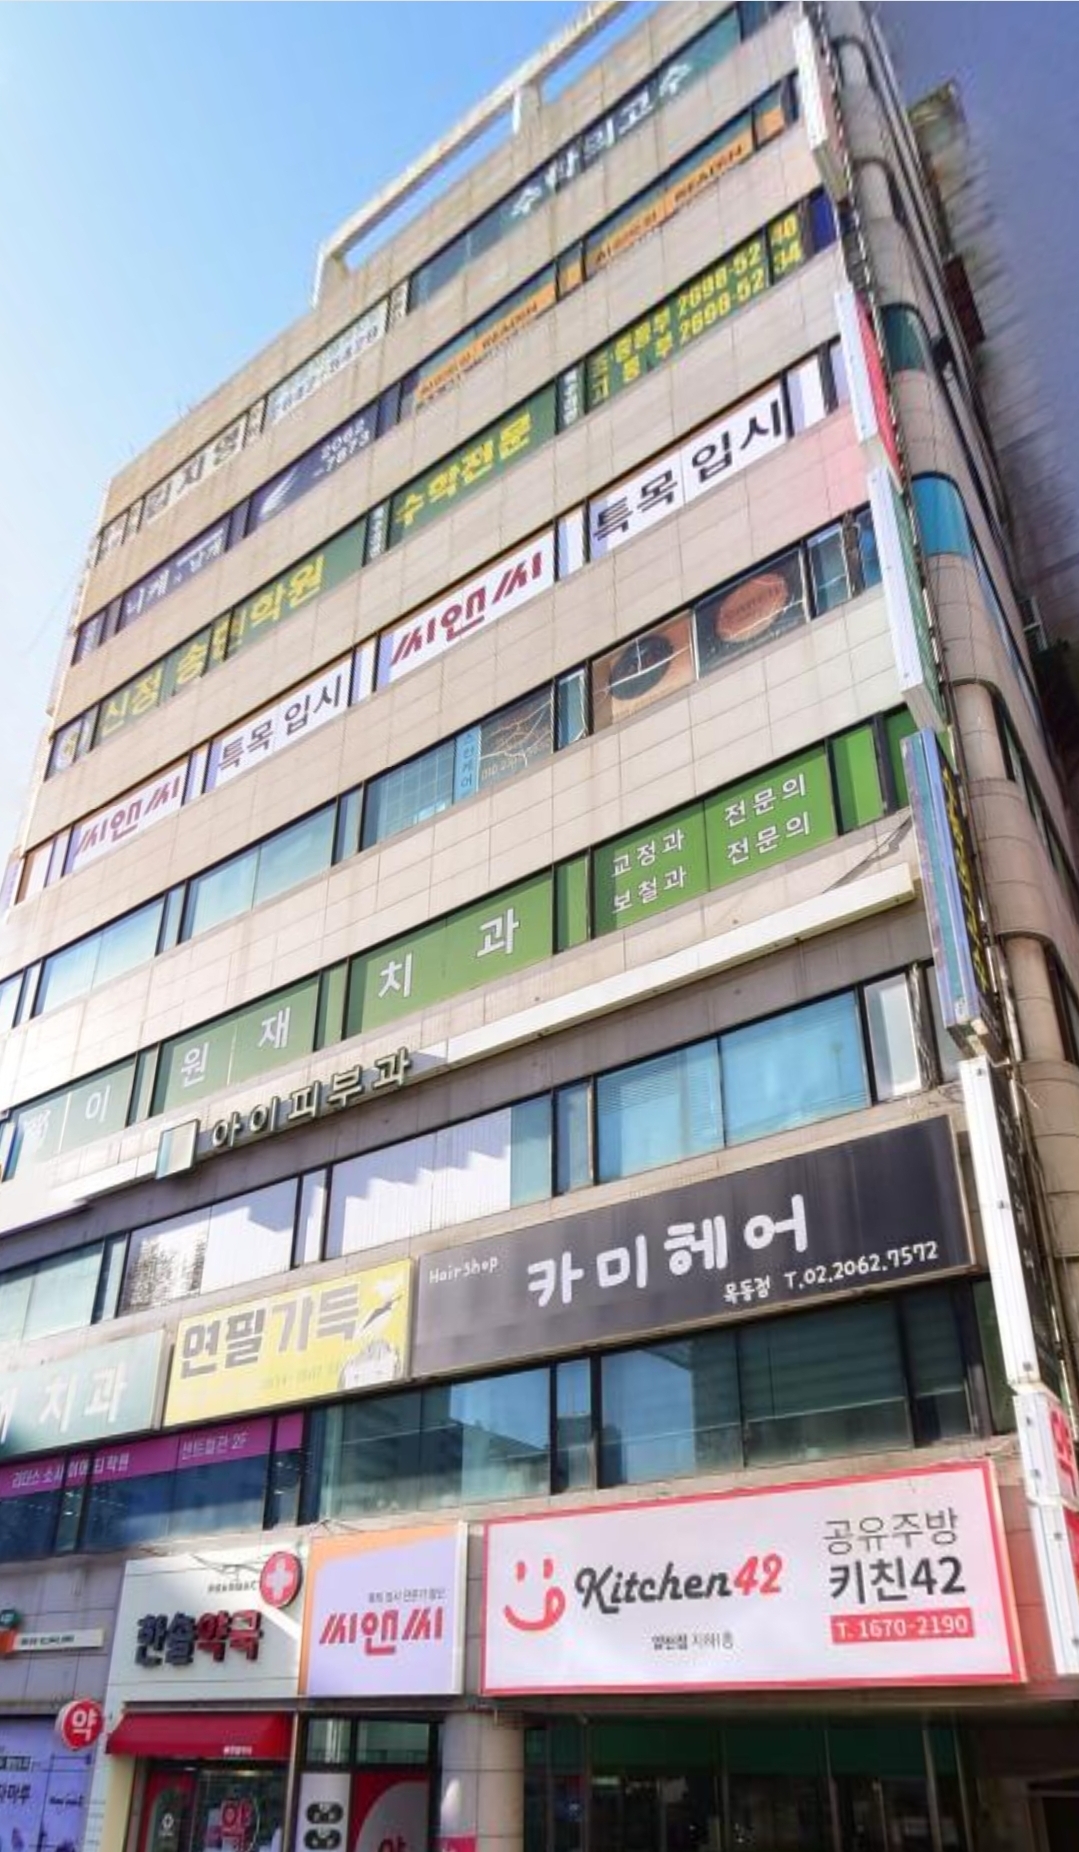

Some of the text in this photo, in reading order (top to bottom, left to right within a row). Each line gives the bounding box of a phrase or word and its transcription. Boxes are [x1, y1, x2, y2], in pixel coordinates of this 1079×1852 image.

[397, 413, 532, 527] 수학전문
[391, 552, 543, 666] 씨앤씨
[611, 773, 808, 879] 교정과 전문의
[611, 811, 812, 915] 보철과 전문의
[211, 1047, 414, 1150] 아이피부과
[527, 1193, 808, 1307] 카미헤어
[724, 1274, 772, 1303] 목동점
[823, 1508, 959, 1555] 공유주방
[574, 1553, 783, 1614] Kitchen42
[829, 1556, 967, 1604] 키친42
[135, 1609, 265, 1667] 한솔약국
[319, 1607, 444, 1655] 씨앤씨
[858, 1612, 968, 1638] 1670-2190
[72, 1708, 98, 1741] 약
